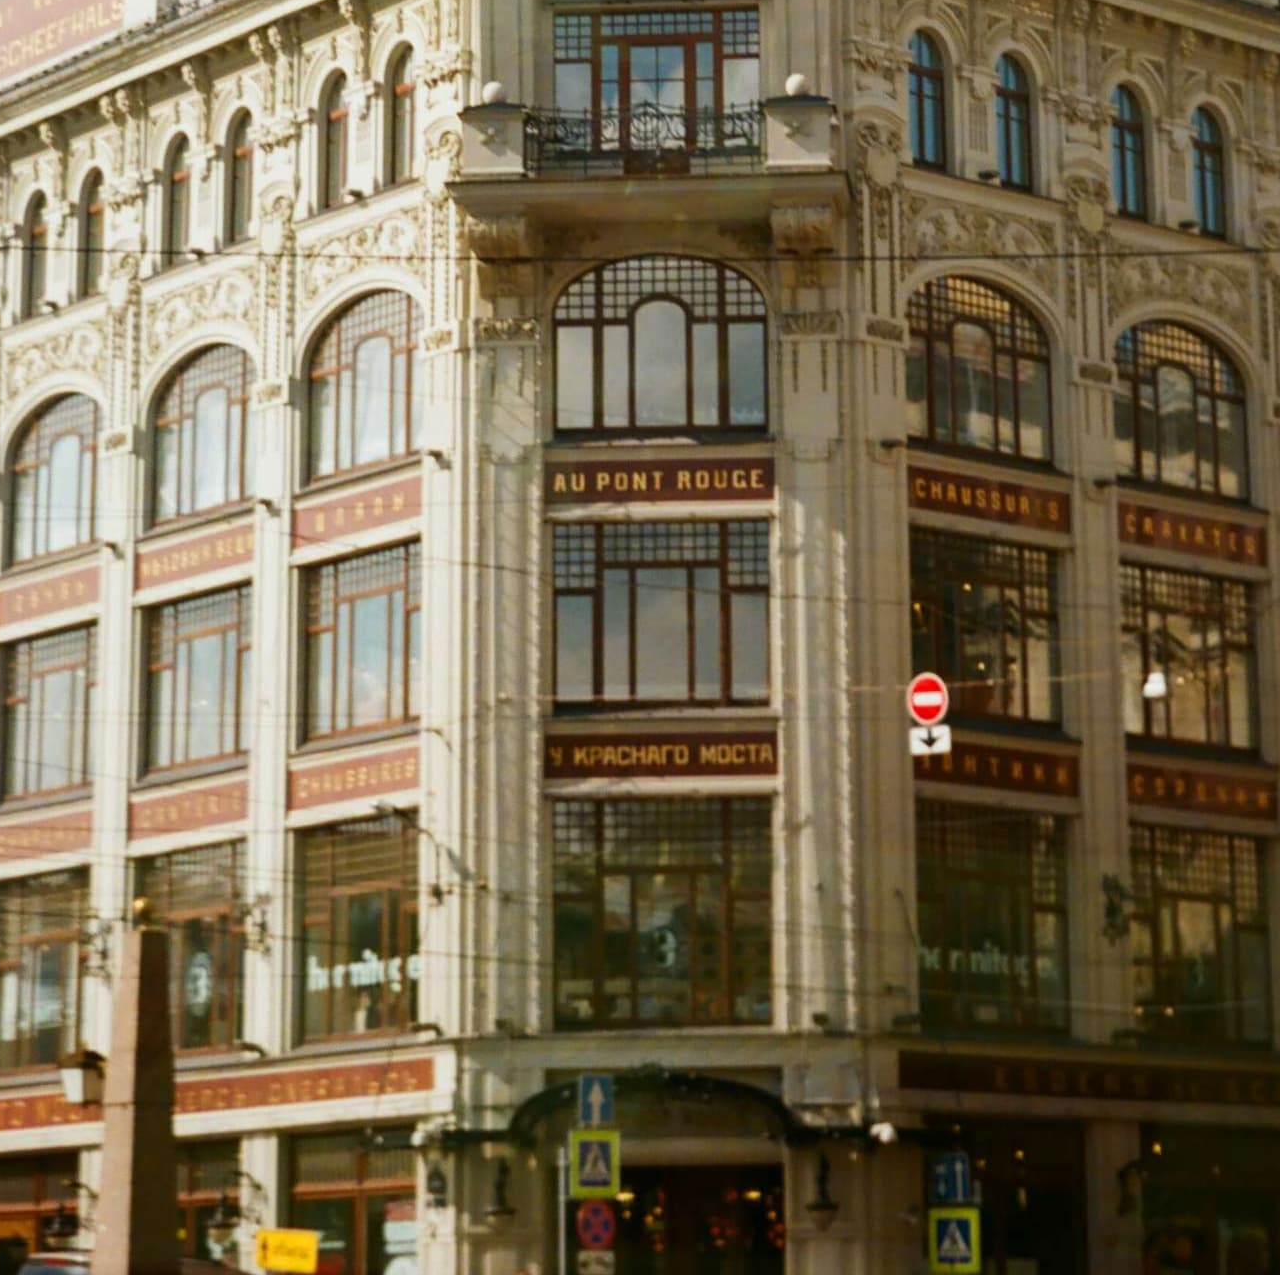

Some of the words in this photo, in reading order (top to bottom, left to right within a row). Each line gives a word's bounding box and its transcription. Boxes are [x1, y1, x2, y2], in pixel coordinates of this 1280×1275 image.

[553, 473, 586, 493] AU
[596, 471, 664, 492] PONT
[676, 469, 764, 490] ROUGE
[913, 478, 1060, 521] CHAUSSURES
[551, 747, 563, 767] У
[573, 745, 690, 766] КРАСНАГО
[701, 744, 774, 765] МОСТА
[298, 757, 416, 798] CHAUSSURES
